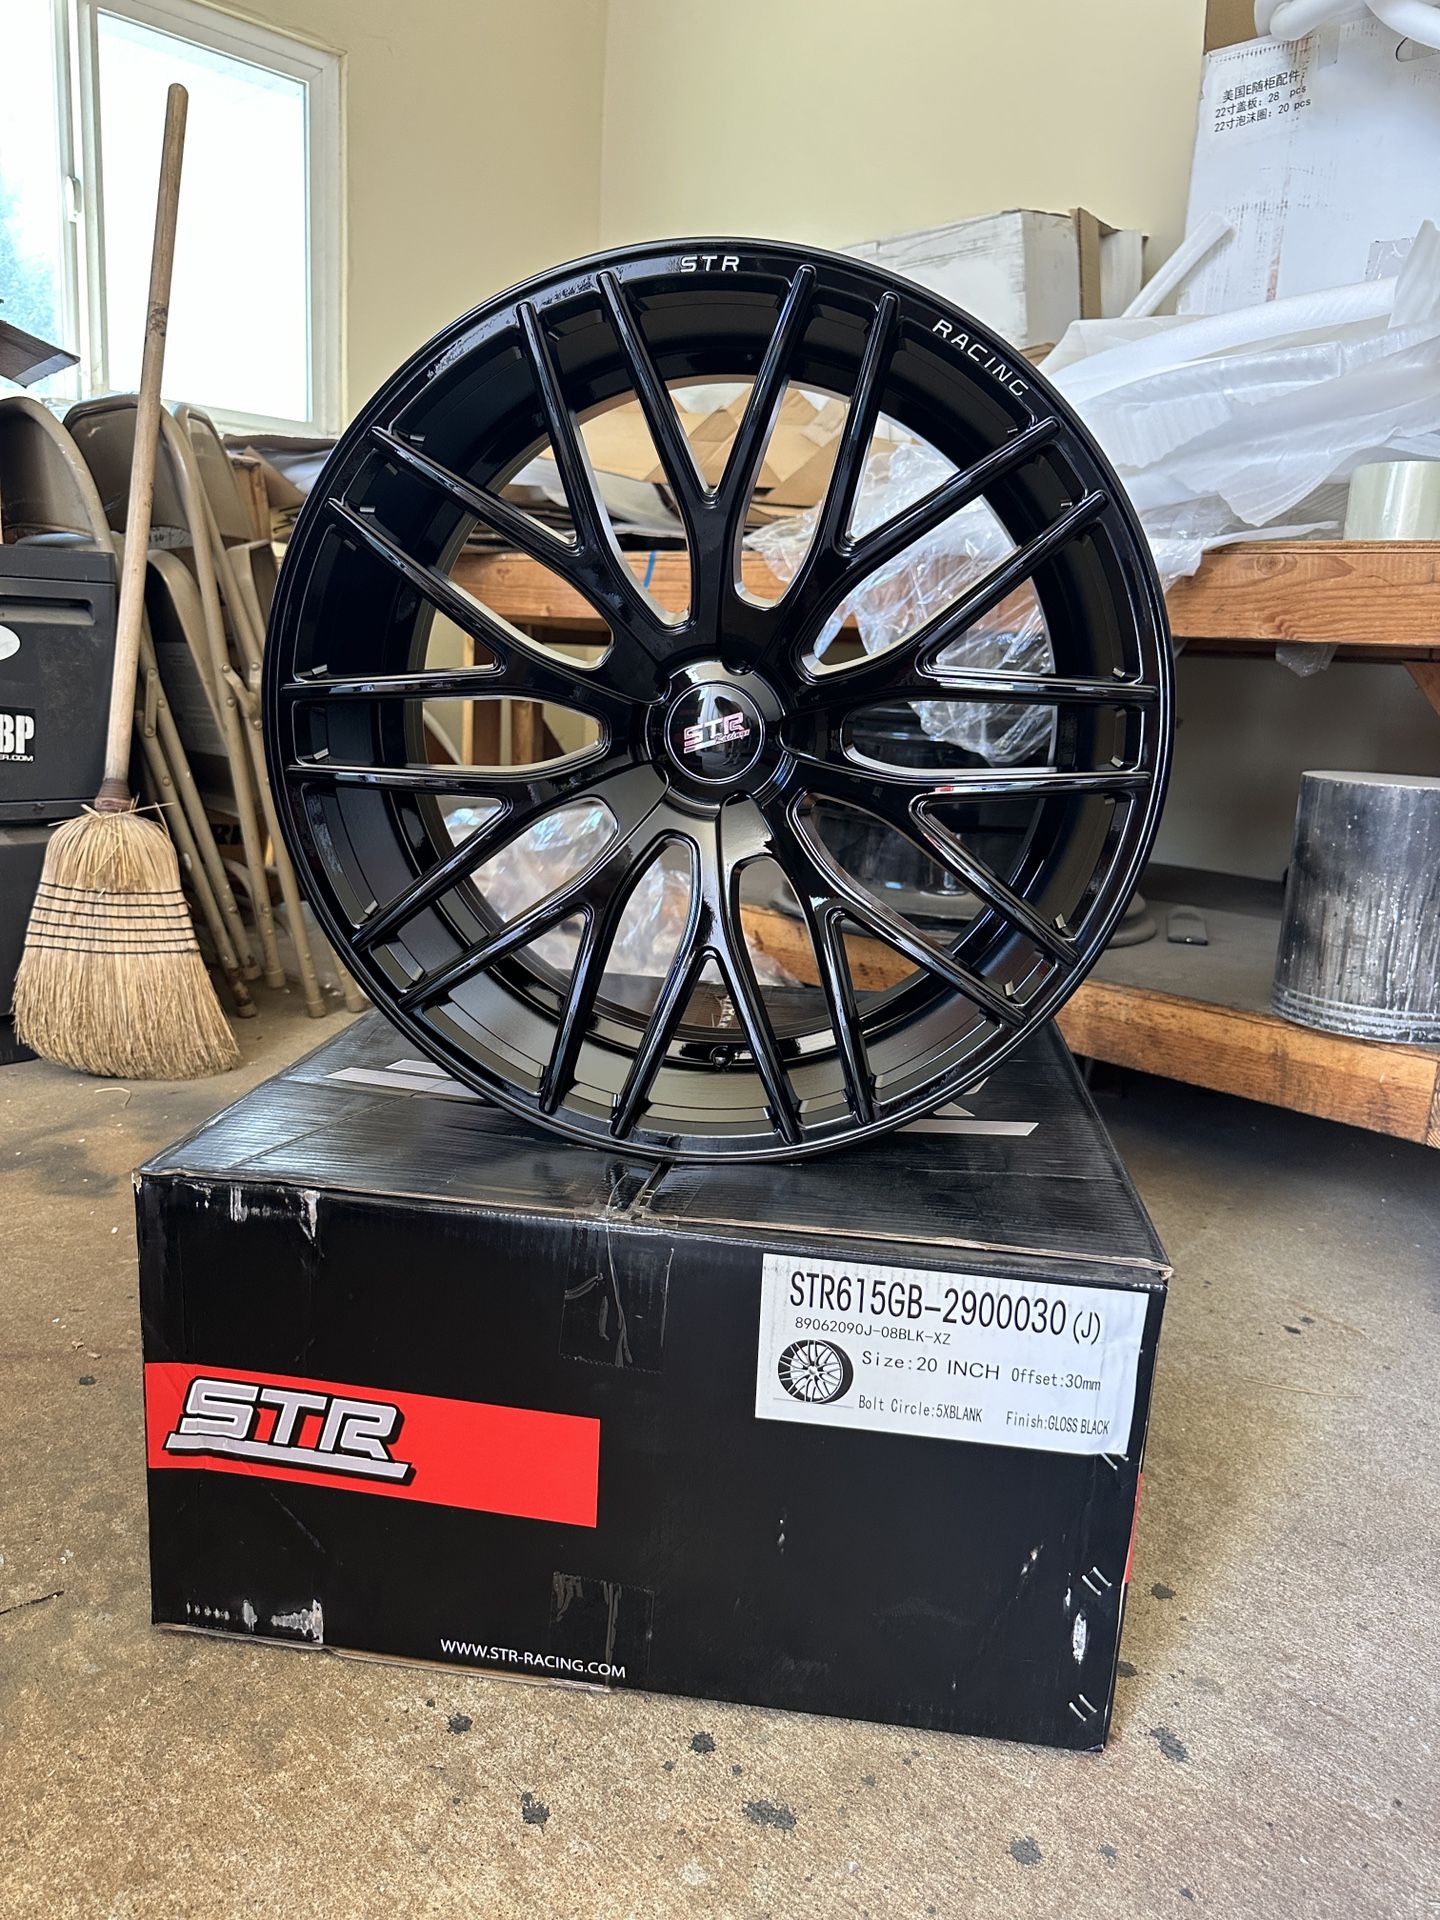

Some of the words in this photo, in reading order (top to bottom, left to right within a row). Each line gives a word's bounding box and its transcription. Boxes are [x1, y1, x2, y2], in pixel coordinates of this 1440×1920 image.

[1289, 85, 1307, 98] pcs
[1294, 98, 1311, 111] pcs
[679, 255, 741, 273] STR
[932, 318, 1030, 398] RACING
[684, 712, 745, 748] STR
[794, 1316, 951, 1346] 89062090J-08BLK-XZ
[861, 1350, 938, 1373] Size:20
[947, 1359, 1000, 1380] INCH
[1011, 1367, 1101, 1391] Offset:30mm
[178, 1377, 399, 1461] STR
[858, 1394, 884, 1412] Bolt
[890, 1398, 983, 1423] Circle:5XBLANK
[1080, 1418, 1110, 1436] BLACK
[440, 1638, 627, 1679] WWW.STR-RACING.COM
